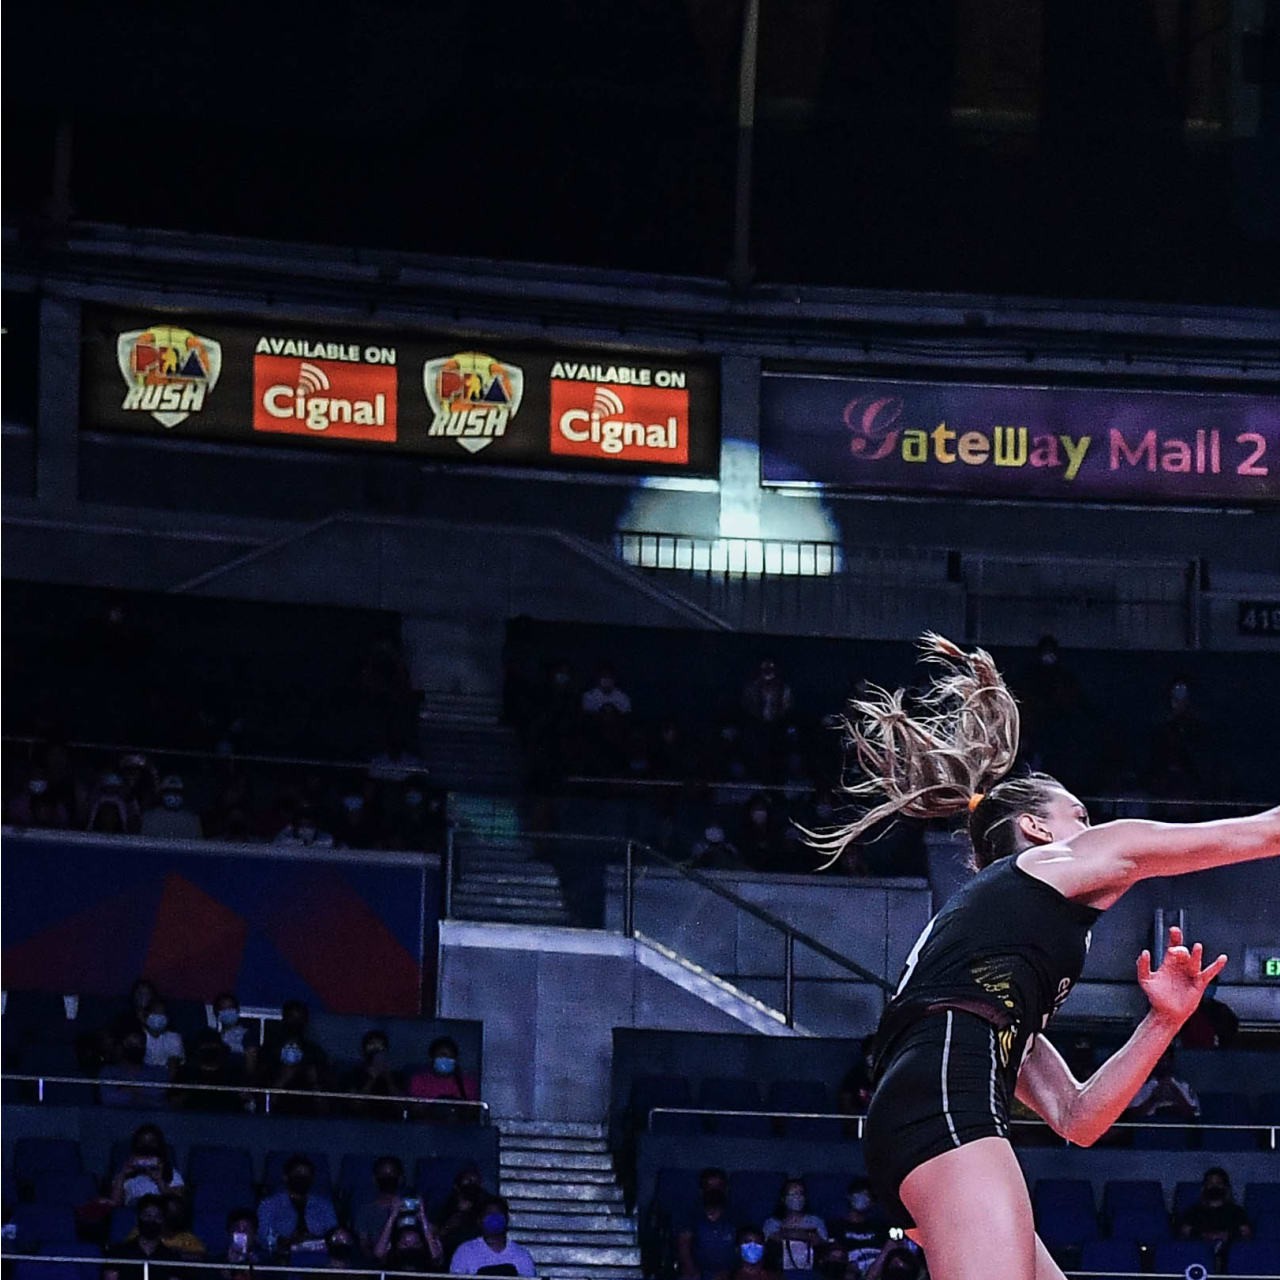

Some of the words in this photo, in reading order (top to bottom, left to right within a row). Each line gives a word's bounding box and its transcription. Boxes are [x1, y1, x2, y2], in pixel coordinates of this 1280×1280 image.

[255, 336, 360, 362] AVAILABLE
[364, 346, 397, 365] ON
[551, 361, 651, 386] AVAILABLE
[655, 370, 686, 388] ON
[122, 382, 206, 411] RUSH
[262, 384, 386, 431] Cignal
[427, 408, 509, 437] RUSH
[559, 408, 678, 454] Cignal
[1108, 427, 1221, 474] Mall
[1235, 432, 1270, 477] 2
